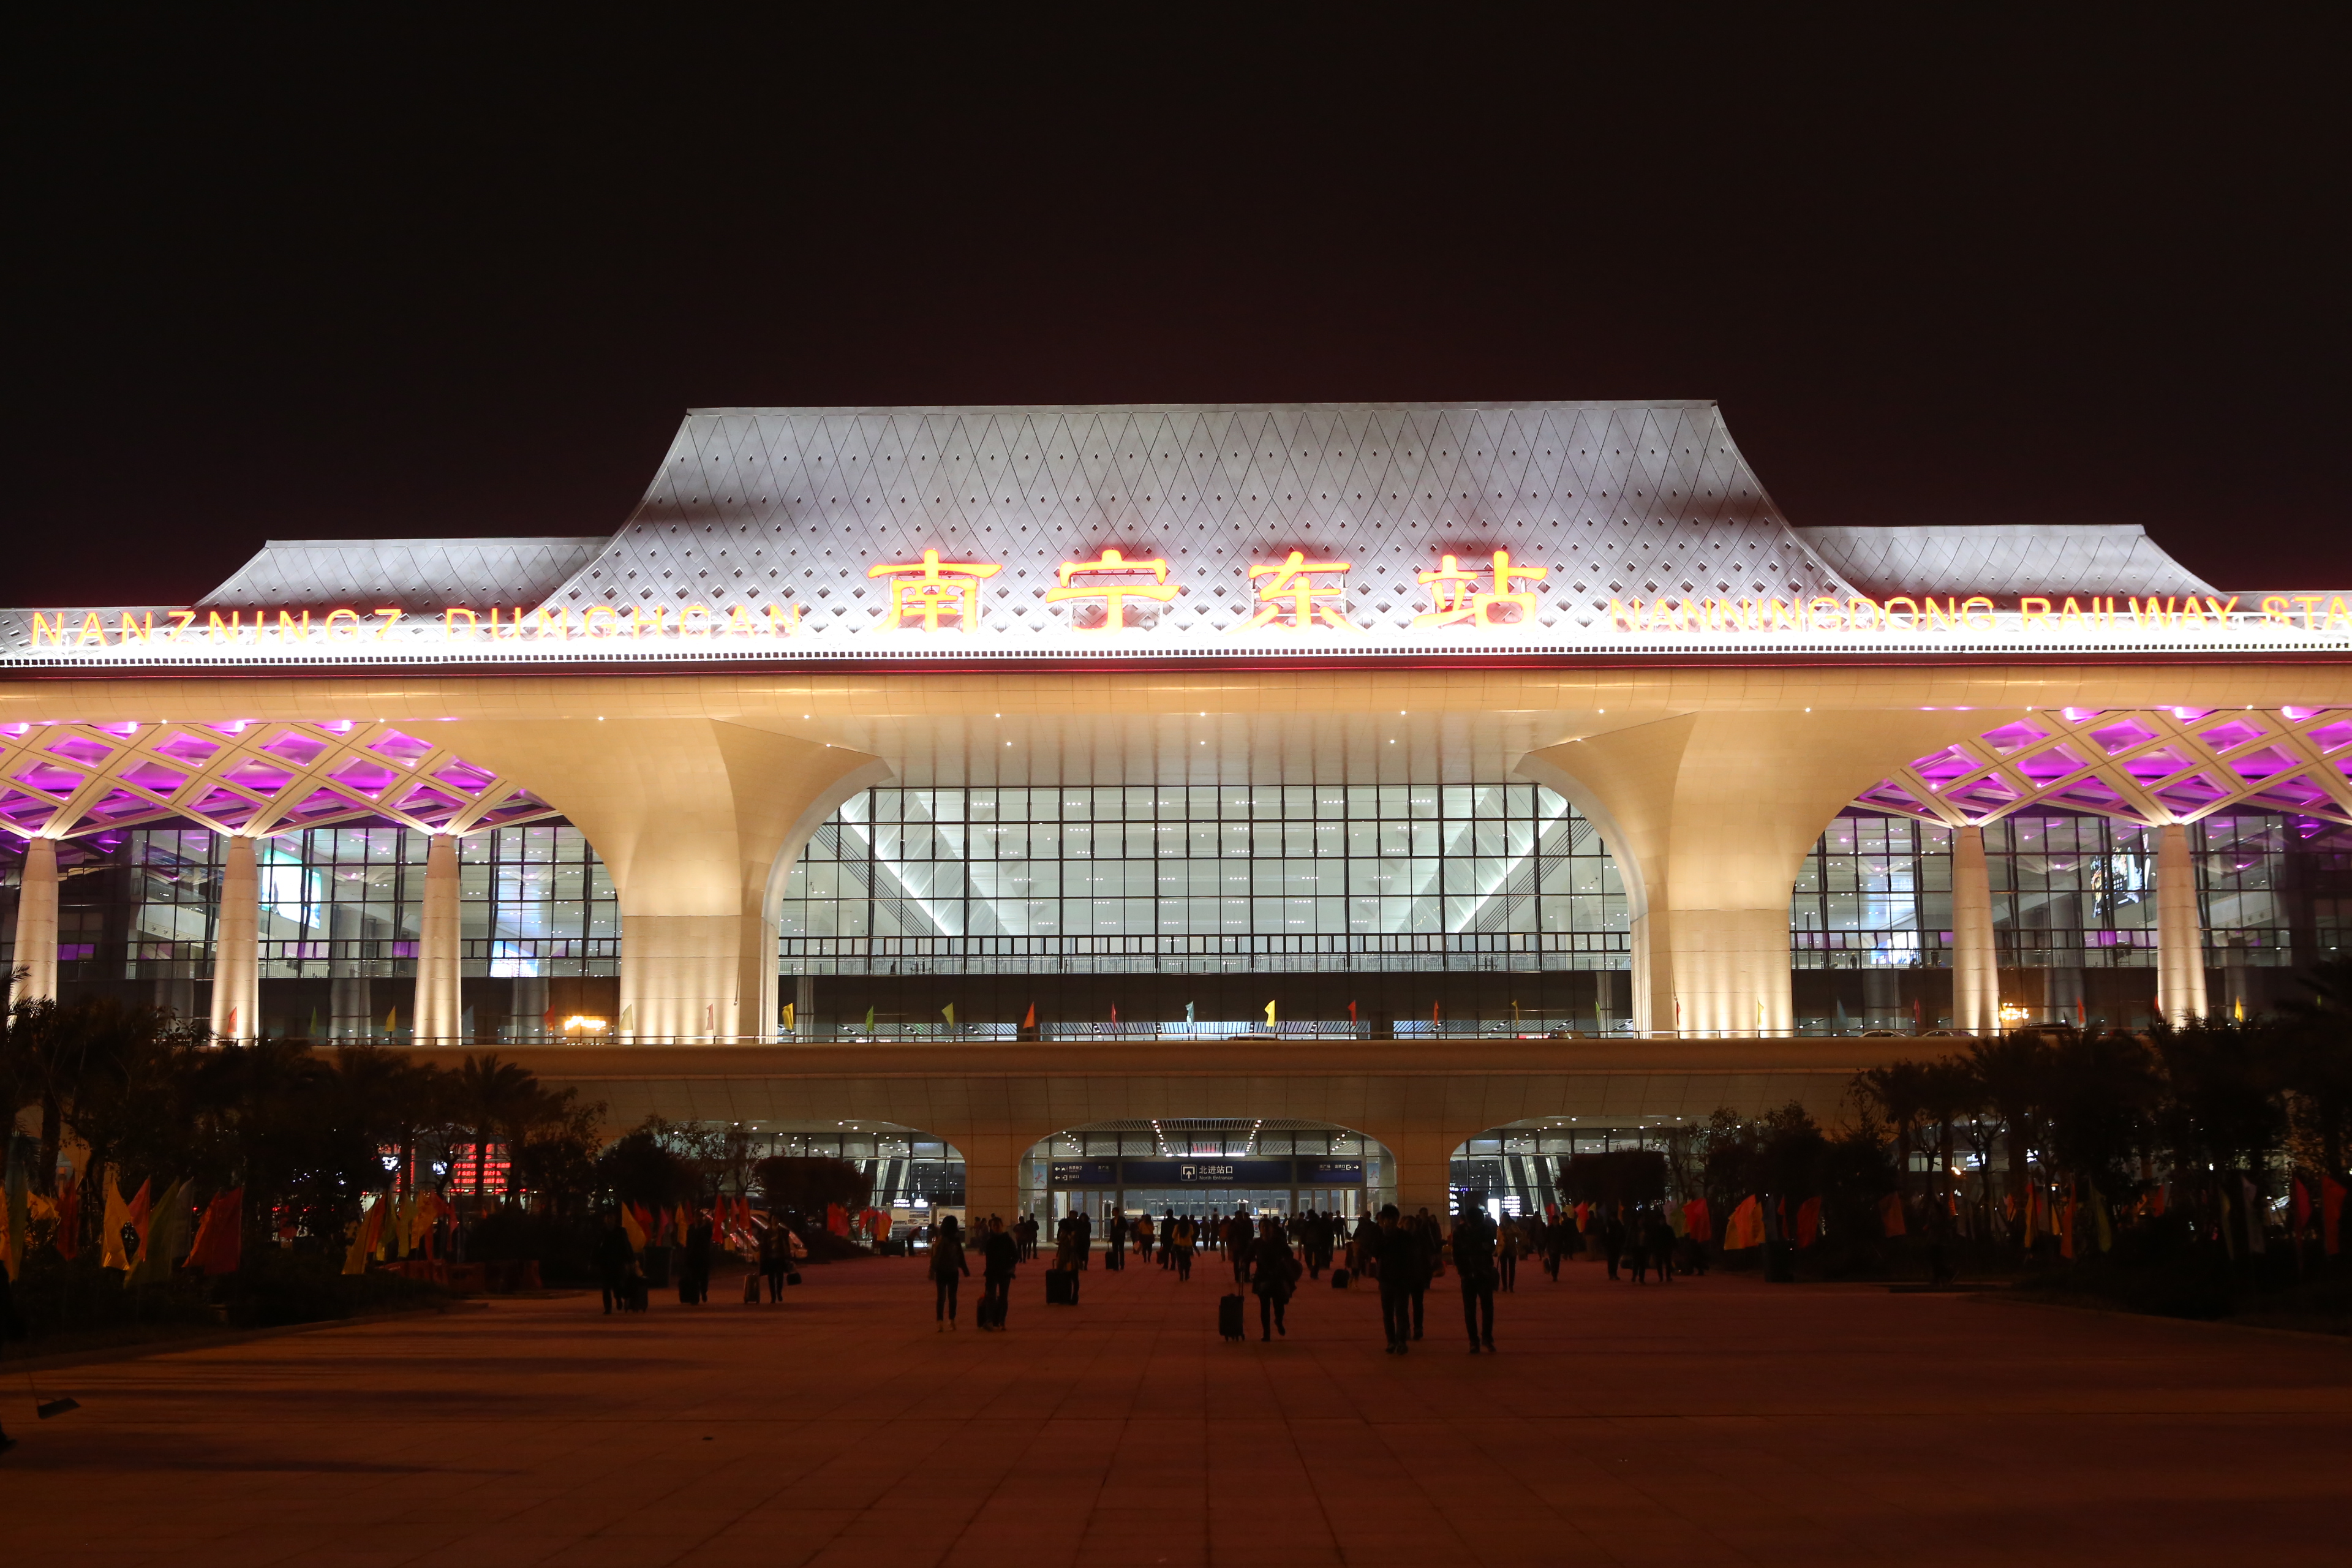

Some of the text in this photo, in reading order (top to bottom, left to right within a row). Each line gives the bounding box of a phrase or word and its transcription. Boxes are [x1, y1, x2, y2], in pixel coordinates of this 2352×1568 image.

[867, 548, 1548, 635] 南宁东站
[31, 603, 801, 647] NANZNINGZ DUNGHCAN
[1610, 596, 1997, 632] NANNINGDONG
[2021, 596, 2239, 631] RAILWAY
[1199, 1165, 1233, 1174] 北进站口
